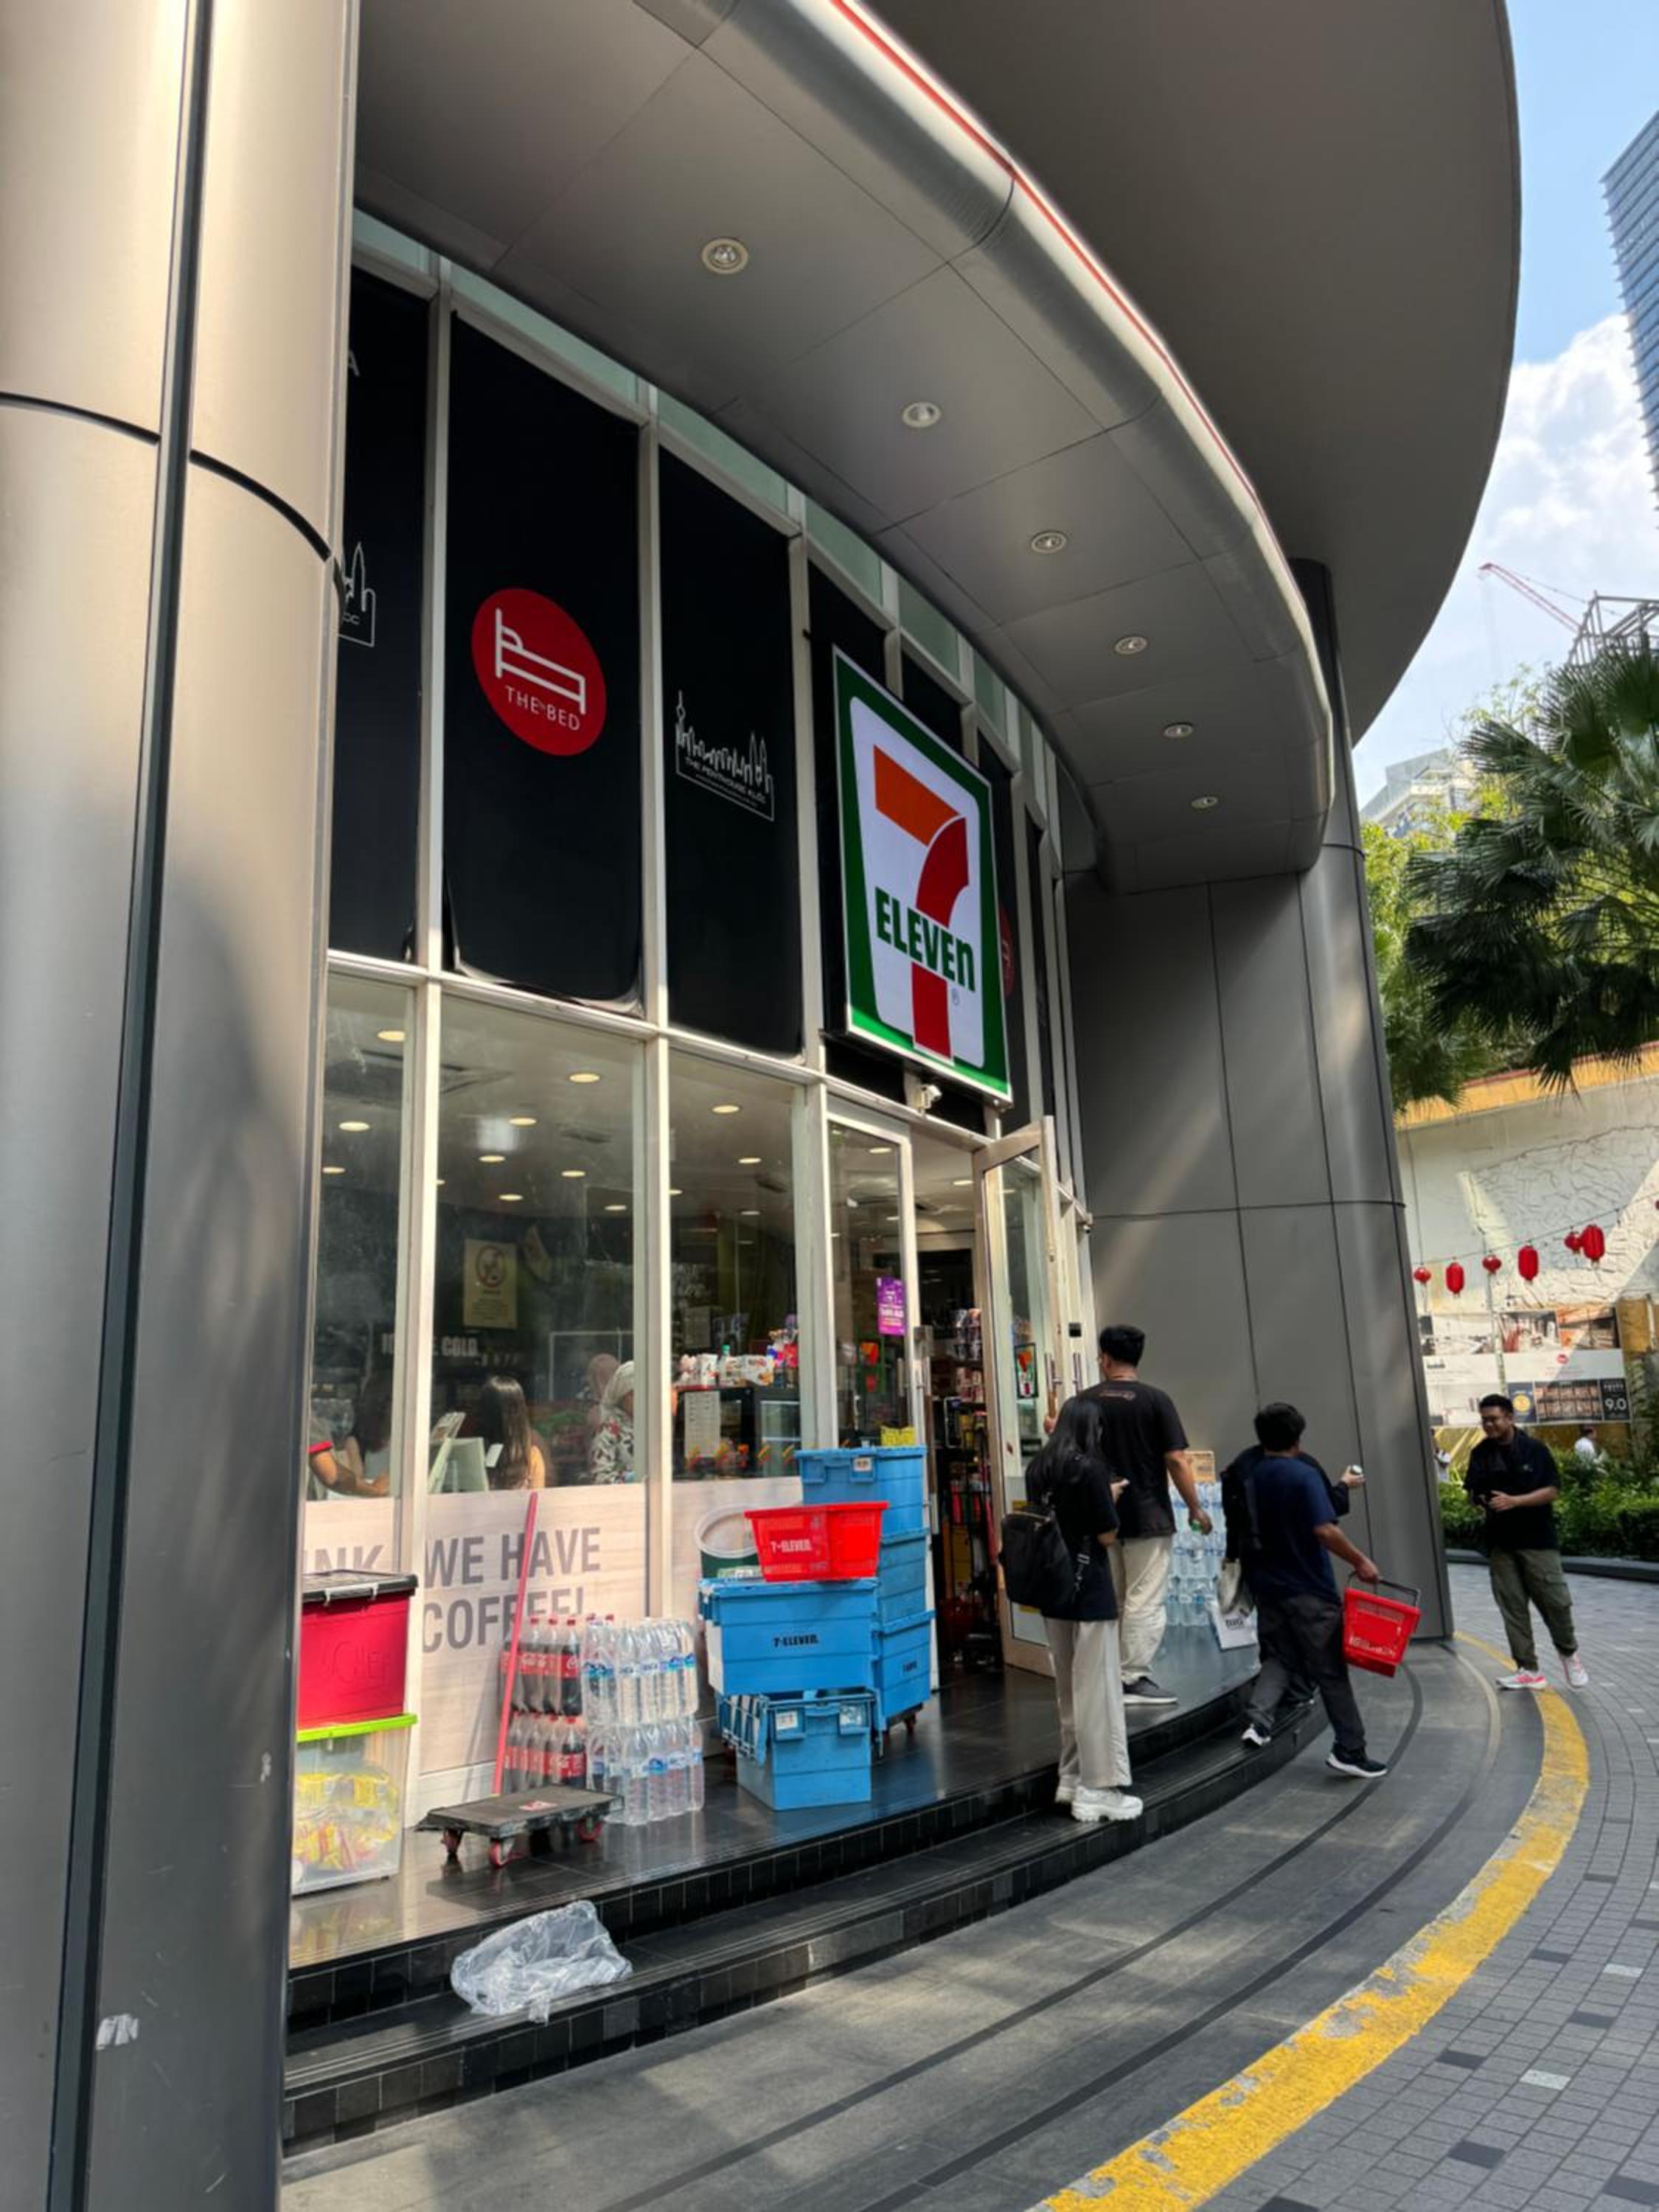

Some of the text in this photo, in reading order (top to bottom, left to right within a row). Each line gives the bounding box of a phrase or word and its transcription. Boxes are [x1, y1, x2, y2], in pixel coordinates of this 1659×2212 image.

[504, 684, 580, 731] THE BED
[873, 744, 969, 1060] 7
[1604, 1397, 1627, 1413] 9.0
[423, 1527, 601, 1589] WE HAVE
